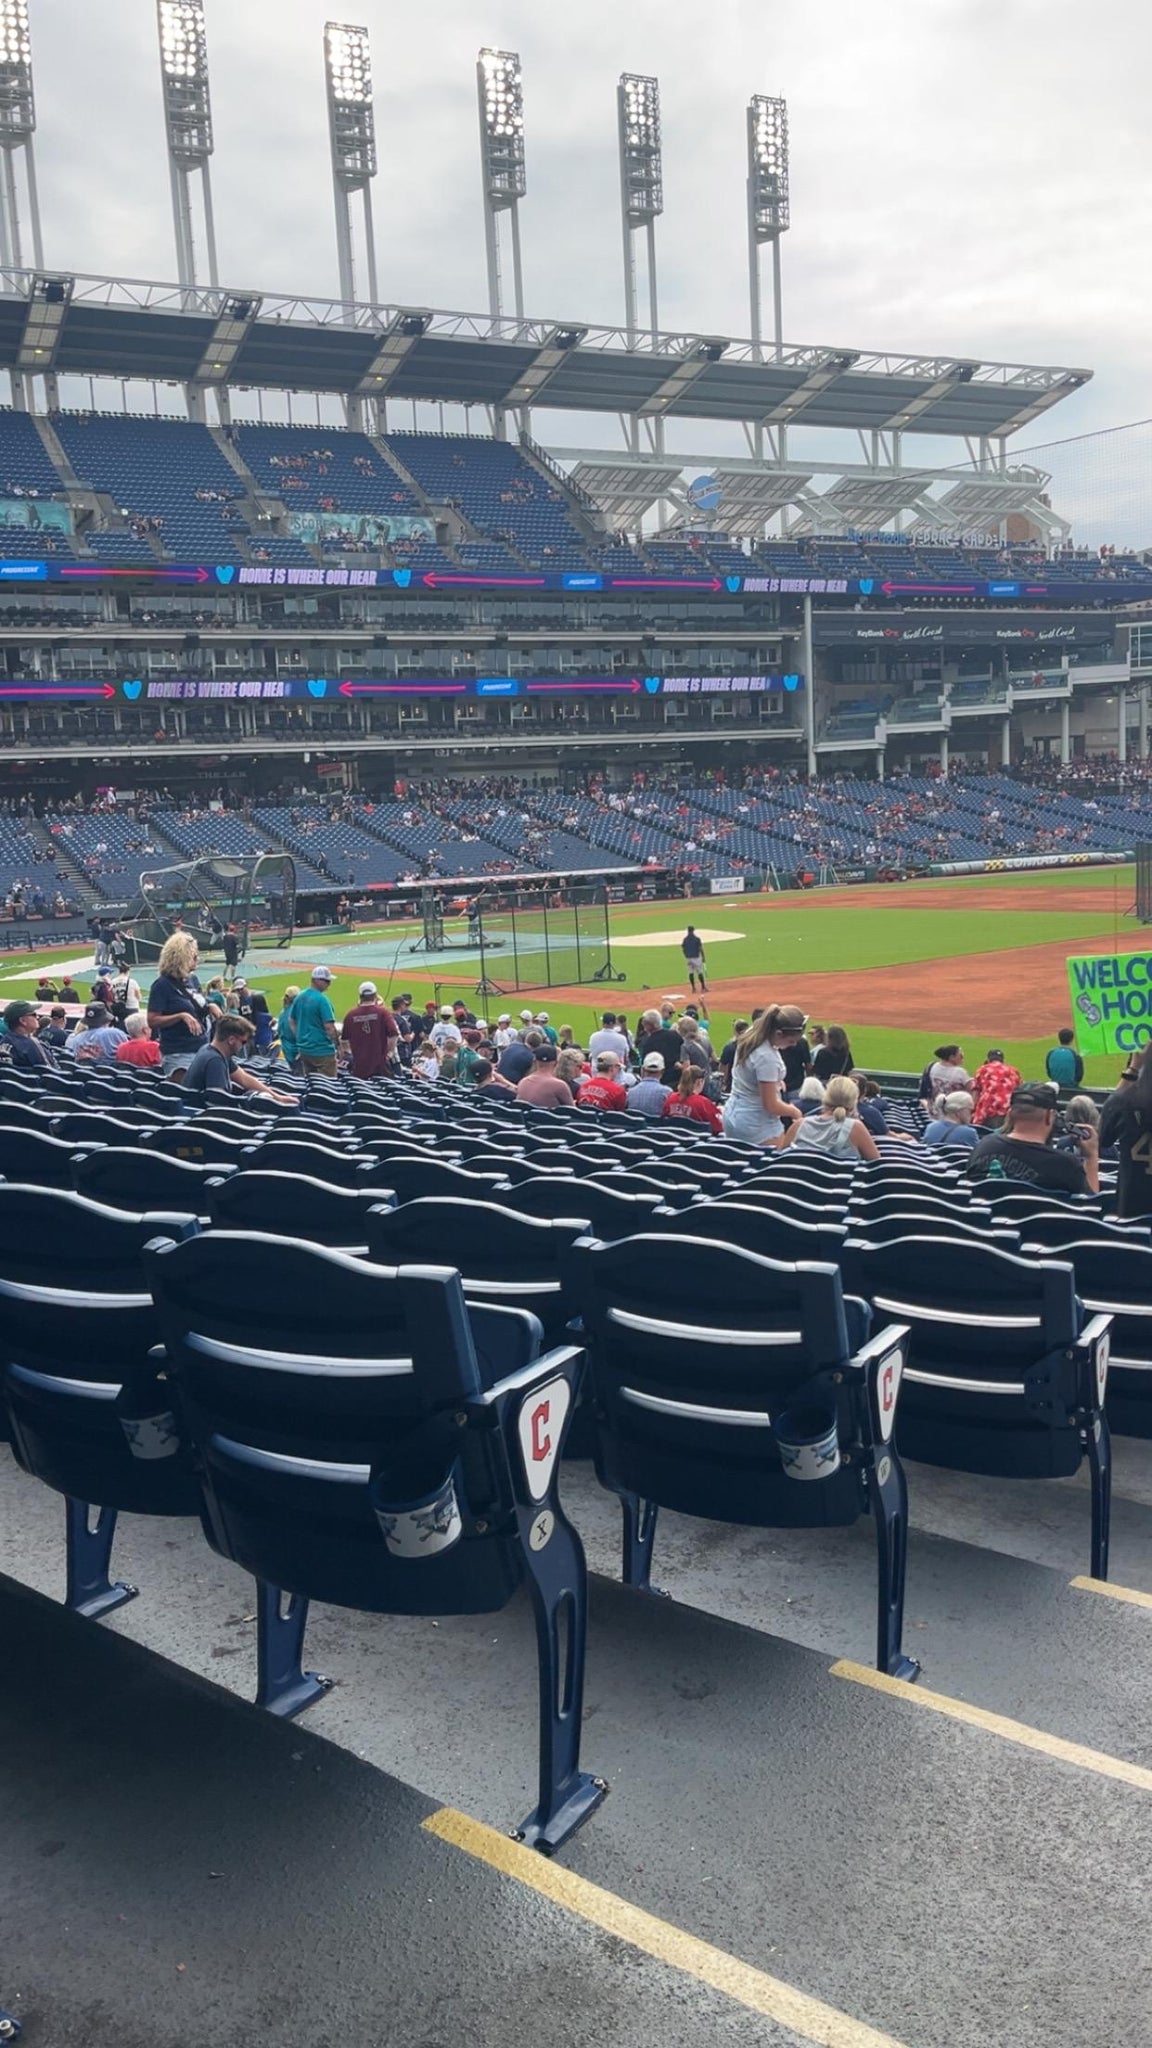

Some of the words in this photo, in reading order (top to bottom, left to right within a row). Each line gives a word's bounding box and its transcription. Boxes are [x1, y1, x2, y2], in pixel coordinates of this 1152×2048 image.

[239, 568, 272, 584] HOME
[273, 569, 287, 584] IS
[287, 569, 325, 585] WHERE
[326, 569, 349, 585] OUR
[350, 570, 377, 585] HEAR
[743, 578, 769, 592] HOME
[769, 579, 779, 592] IS
[780, 579, 808, 593] WHERE
[808, 579, 827, 593] OUR
[827, 580, 848, 593] HEAR
[147, 682, 182, 698] HOME
[183, 682, 197, 698] IS
[198, 682, 239, 698] WHERE
[239, 682, 262, 698] OUR
[263, 681, 291, 698] HEA
[663, 678, 690, 692] HOME
[690, 678, 700, 692] IS
[701, 677, 731, 691] WHERE
[731, 677, 749, 691] OUR
[750, 676, 770, 691] HEA
[1073, 957, 1152, 990] WELC
[1101, 989, 1152, 1020] HO
[883, 1366, 893, 1411] C
[531, 1400, 551, 1461] C
[537, 1518, 547, 1541] X
